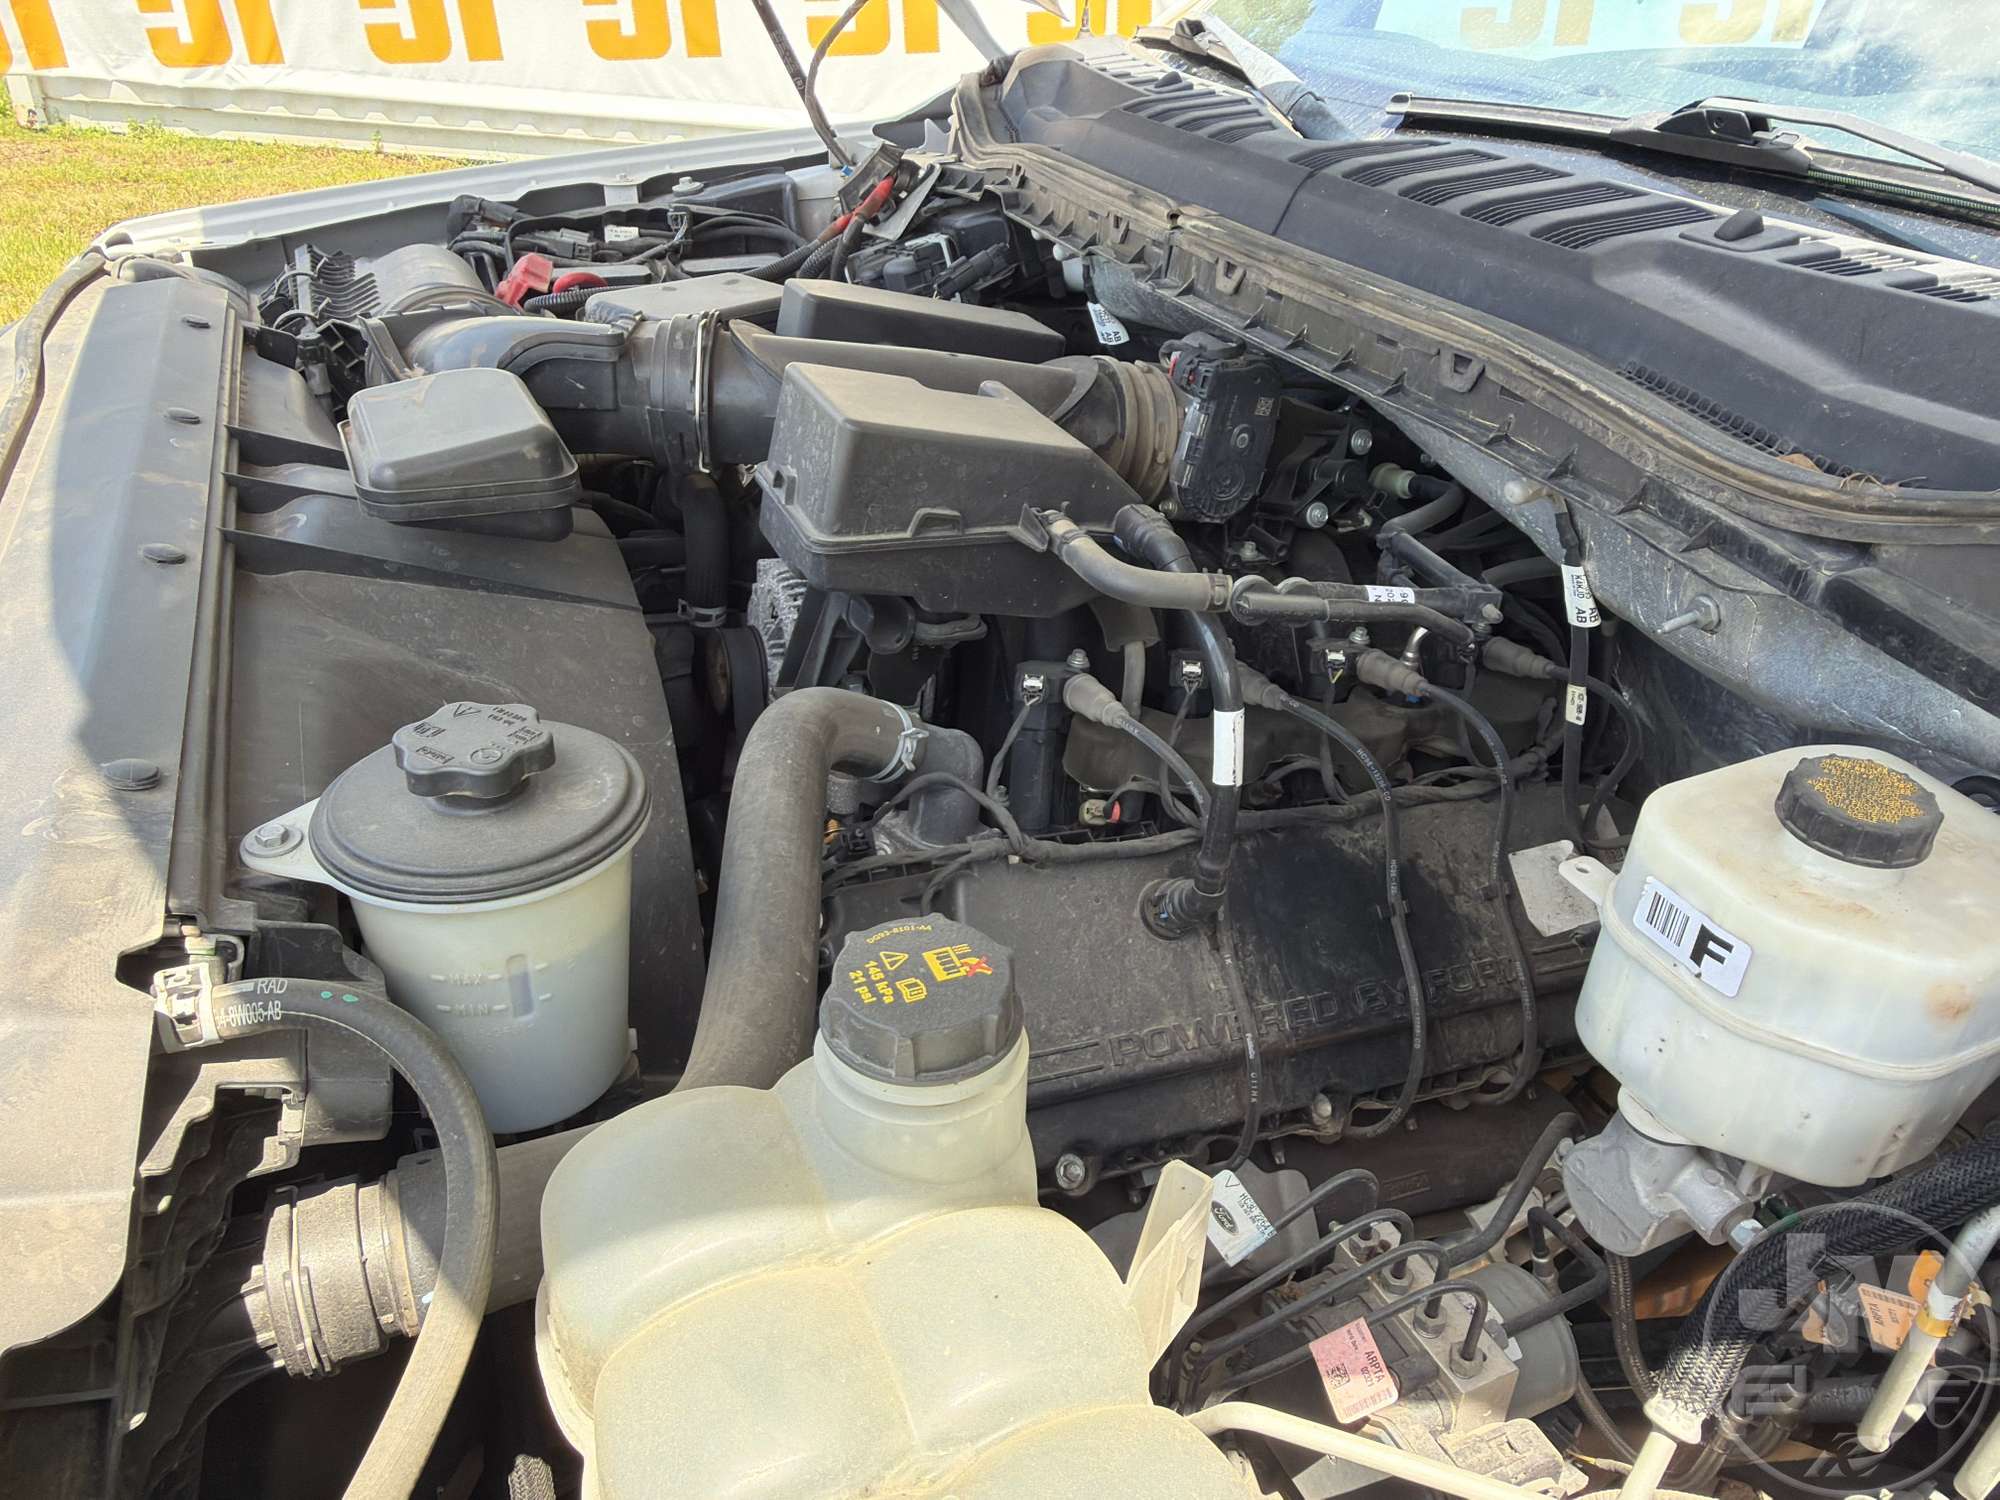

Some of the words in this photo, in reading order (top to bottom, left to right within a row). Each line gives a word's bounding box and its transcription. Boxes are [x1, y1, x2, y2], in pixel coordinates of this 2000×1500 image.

[1575, 606, 1588, 624] AB
[1689, 923, 1735, 969] F
[256, 979, 289, 995] RAD
